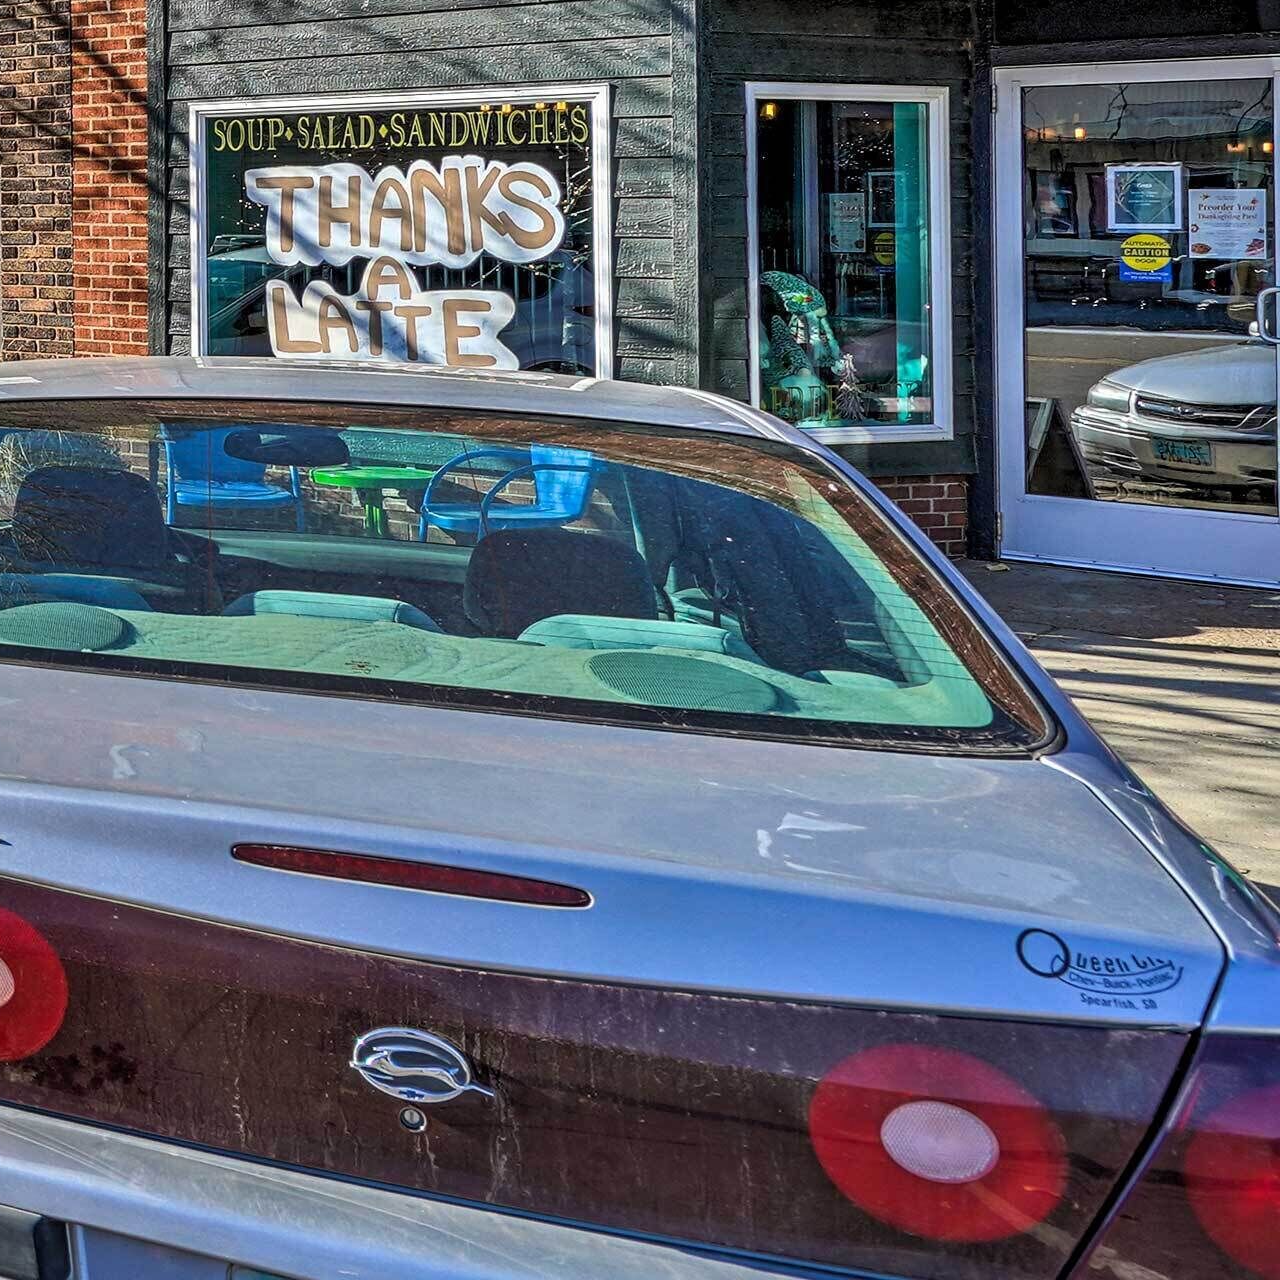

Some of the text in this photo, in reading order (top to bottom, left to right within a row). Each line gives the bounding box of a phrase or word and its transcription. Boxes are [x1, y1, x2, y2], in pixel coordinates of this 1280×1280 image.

[213, 105, 590, 152] SOUP SALAD SANDWICHES
[255, 165, 557, 256] THANKS
[1198, 203, 1257, 211] Preorder Your
[1124, 248, 1170, 256] CAUTION
[366, 255, 413, 301] A
[271, 286, 497, 368] LATTE
[1015, 927, 1131, 978] Queen
